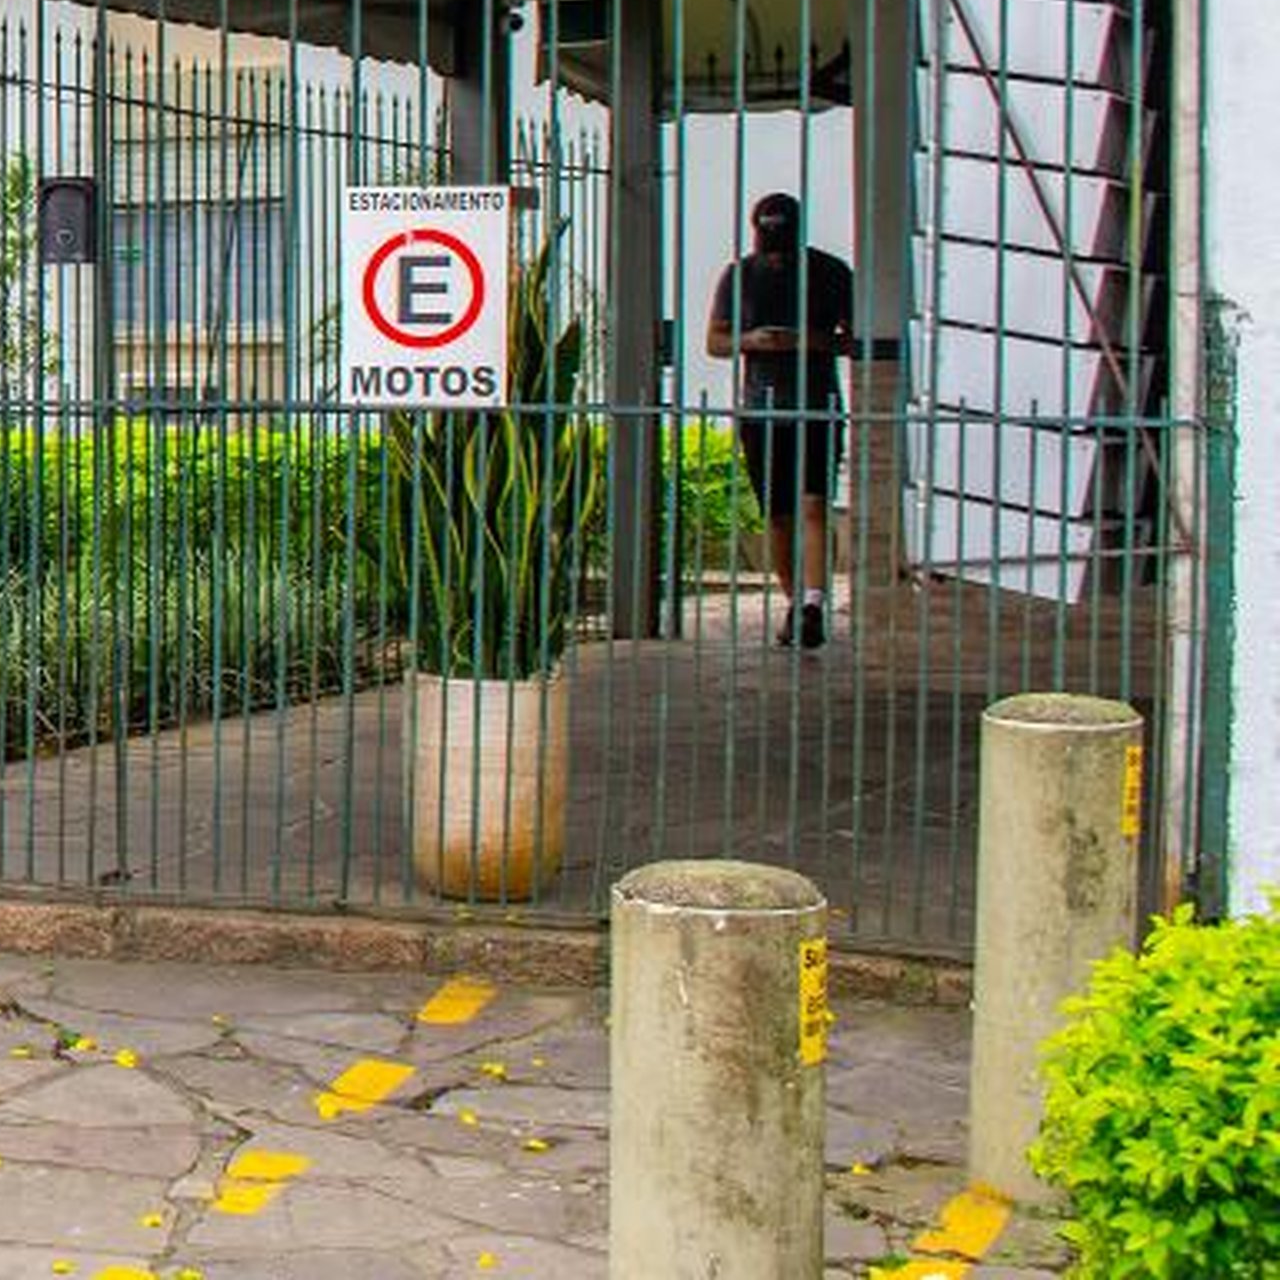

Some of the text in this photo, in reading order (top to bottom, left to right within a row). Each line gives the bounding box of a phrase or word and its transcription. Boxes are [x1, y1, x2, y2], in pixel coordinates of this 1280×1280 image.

[349, 192, 504, 211] ESTACIONAMENTO
[397, 256, 452, 324] E
[350, 367, 496, 397] MOTOS
